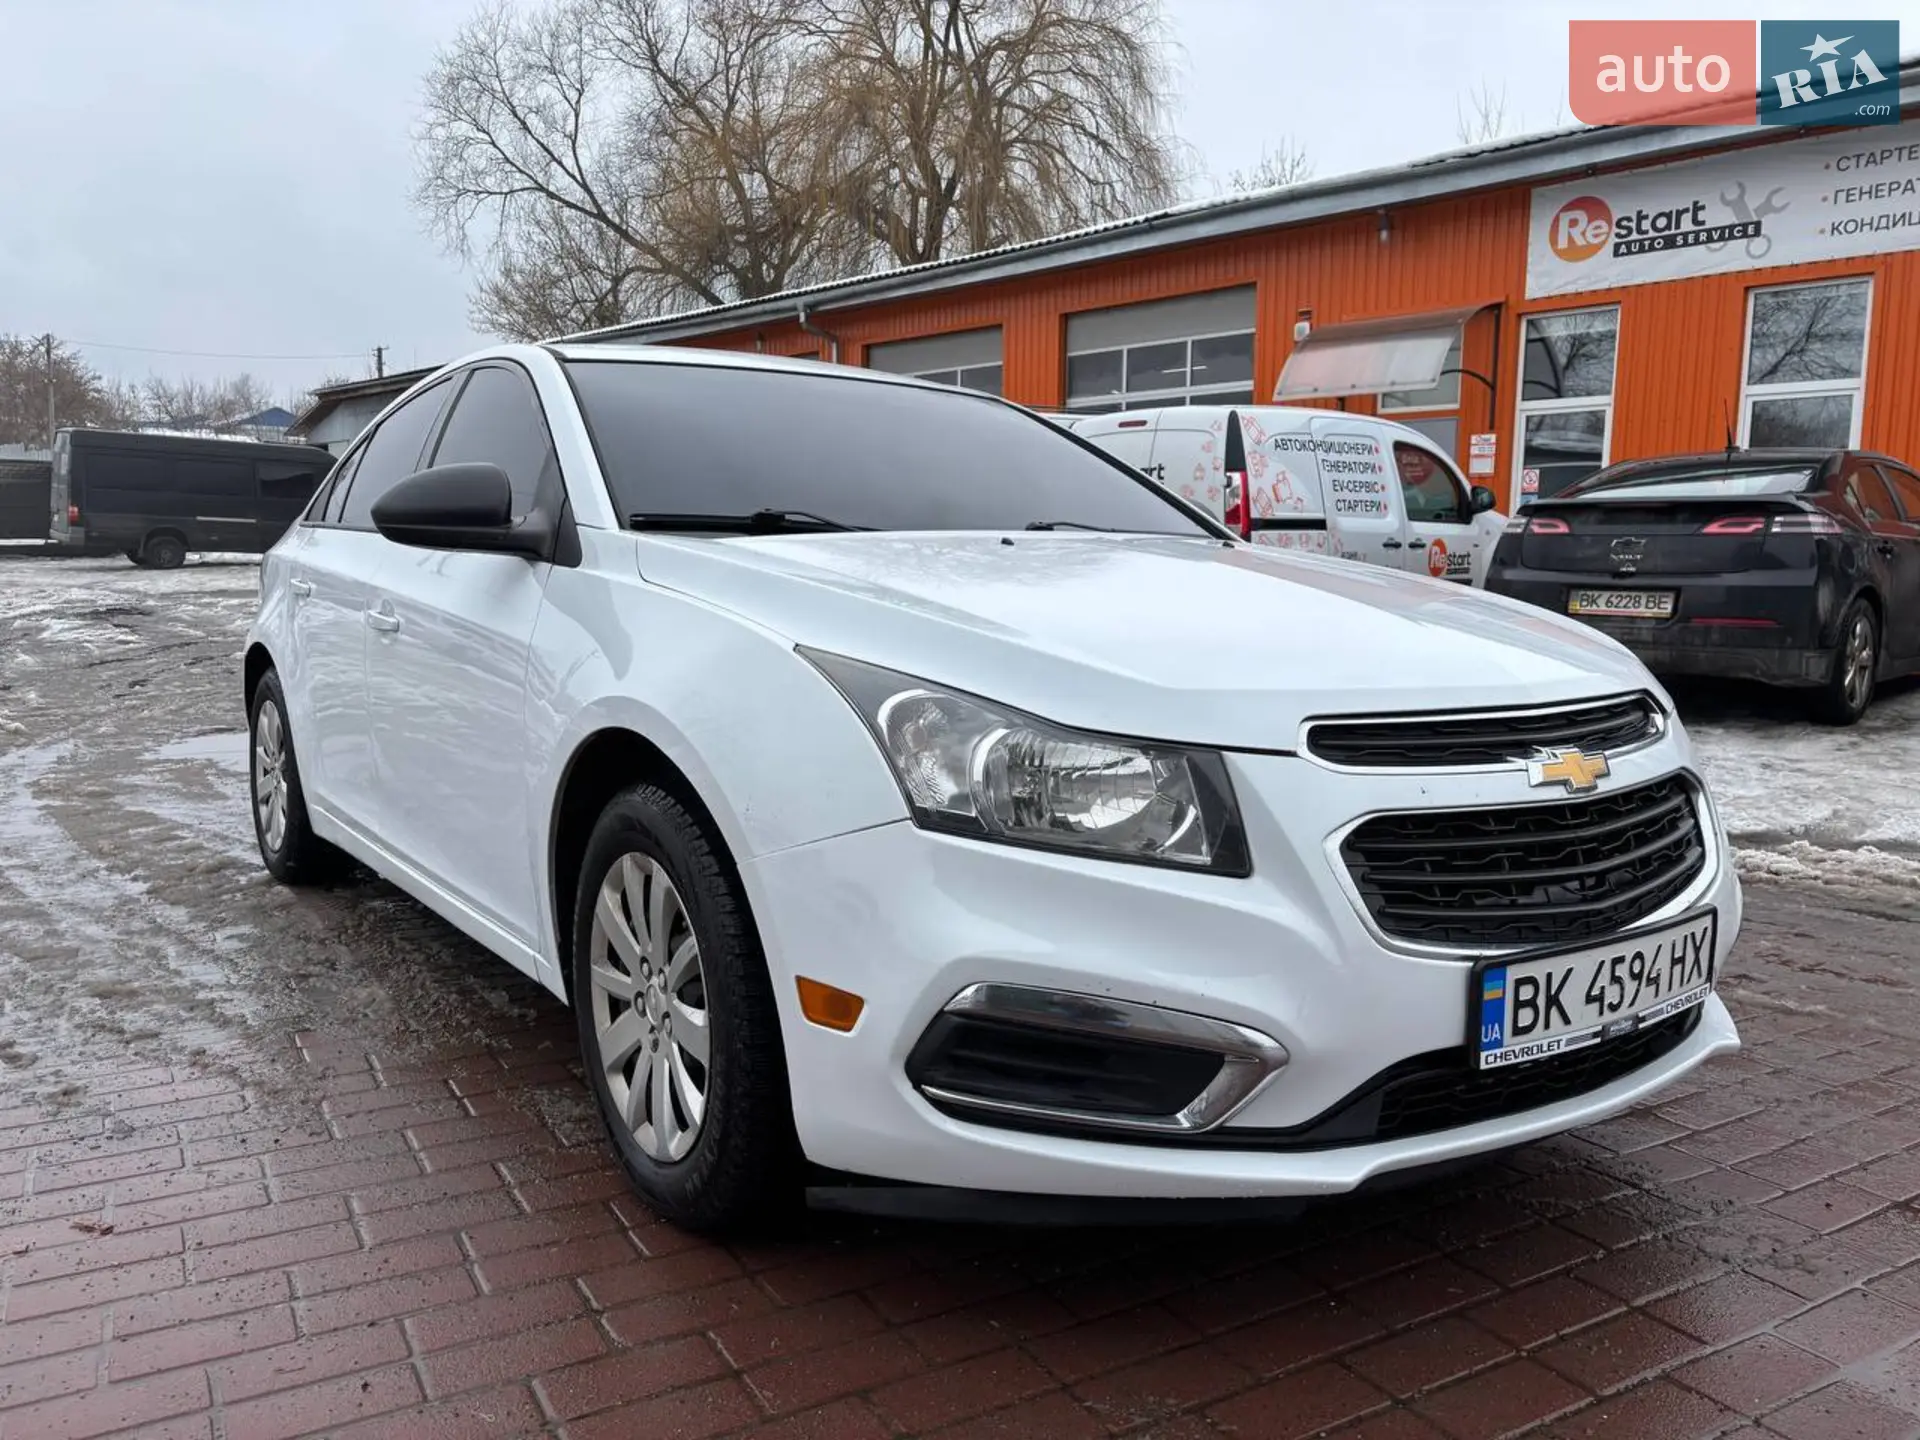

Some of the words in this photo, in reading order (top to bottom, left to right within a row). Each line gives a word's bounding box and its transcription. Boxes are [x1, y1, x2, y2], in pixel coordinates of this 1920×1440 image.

[1836, 144, 1920, 172] СТАРТЕ
[1557, 200, 1706, 250] Restart
[1618, 238, 1665, 254] AUTO
[1676, 224, 1756, 244] SERVICE
[1335, 499, 1382, 513] СТАРТЕРИ
[1580, 593, 1602, 608] BK
[1605, 594, 1642, 609] 6228
[1645, 594, 1669, 610] BE
[1511, 966, 1575, 1038] BK
[1585, 943, 1663, 1017] 4594
[1667, 926, 1709, 992] HX
[1665, 986, 1710, 1015] CHEVROLET
[1481, 1023, 1502, 1044] UA
[1484, 1037, 1565, 1067] CHEVROLET
